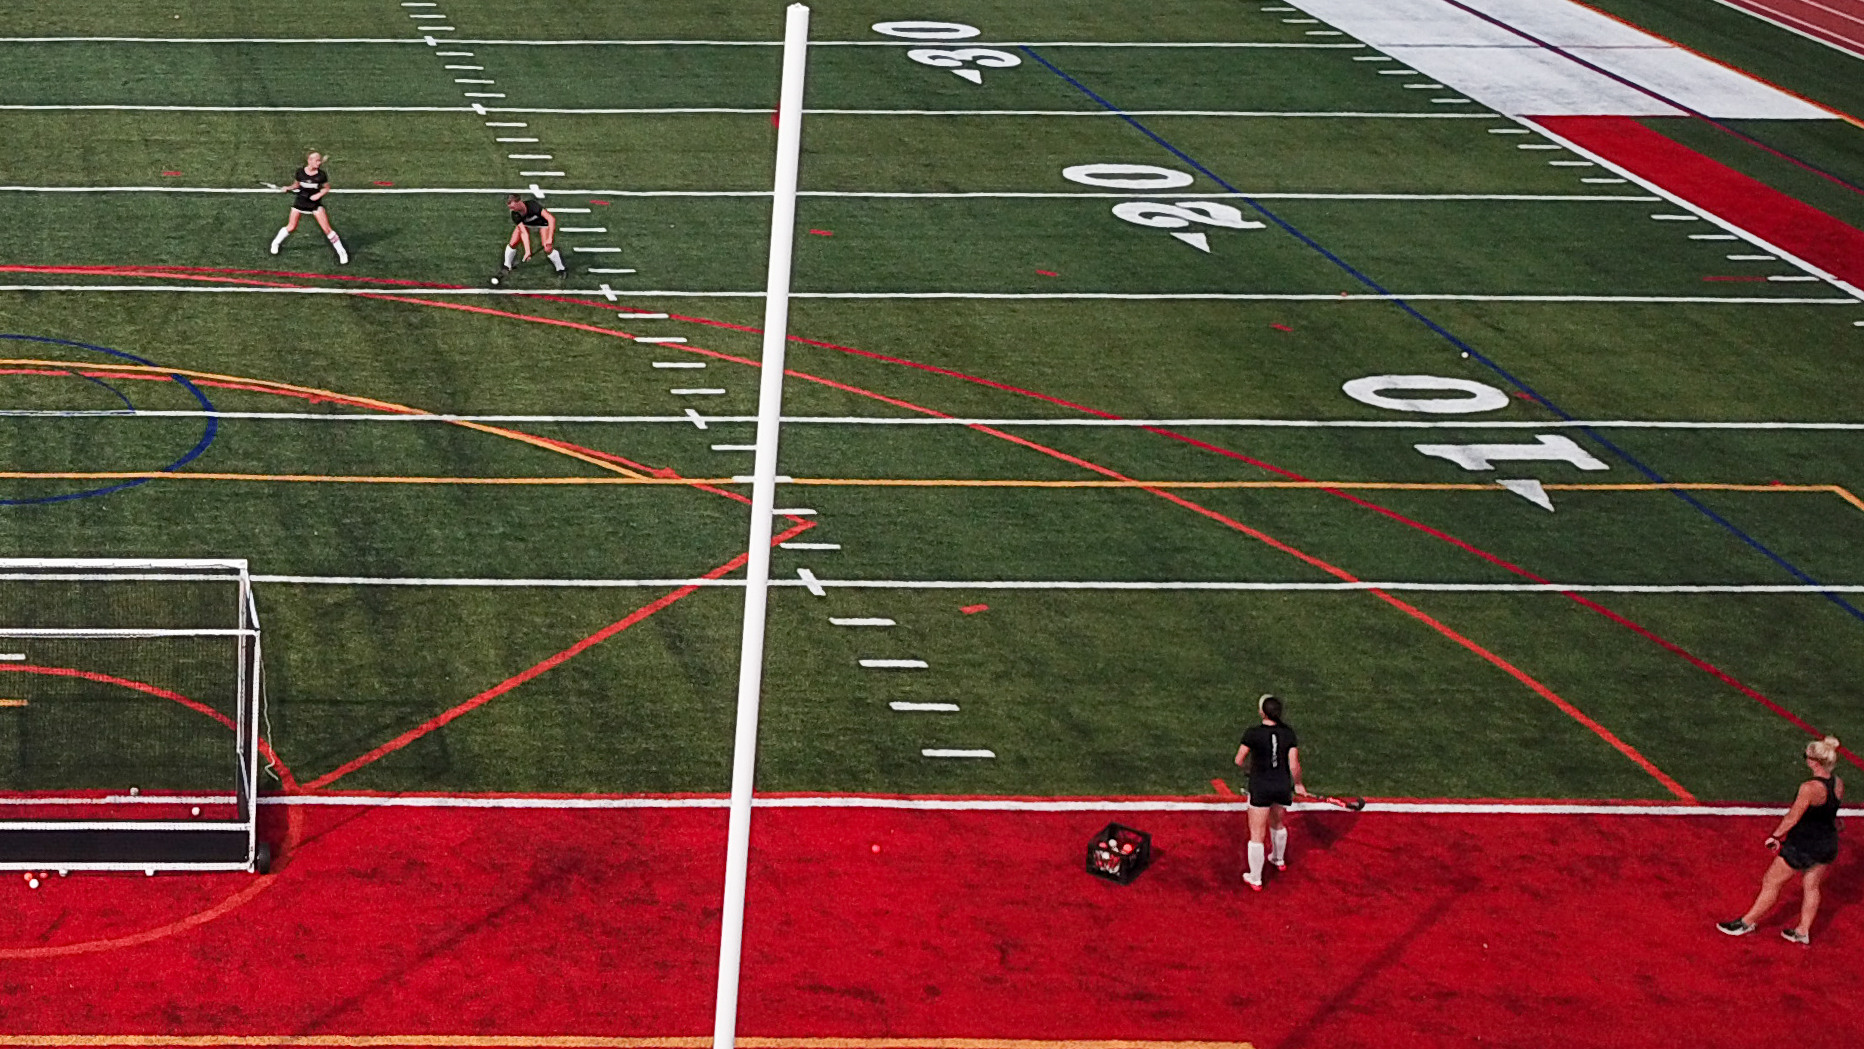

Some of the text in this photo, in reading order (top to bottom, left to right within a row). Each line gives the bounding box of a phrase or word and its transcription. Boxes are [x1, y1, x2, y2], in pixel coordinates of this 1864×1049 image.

[872, 20, 1022, 69] 30
[1062, 163, 1266, 229] 20
[1342, 374, 1609, 472] 10
